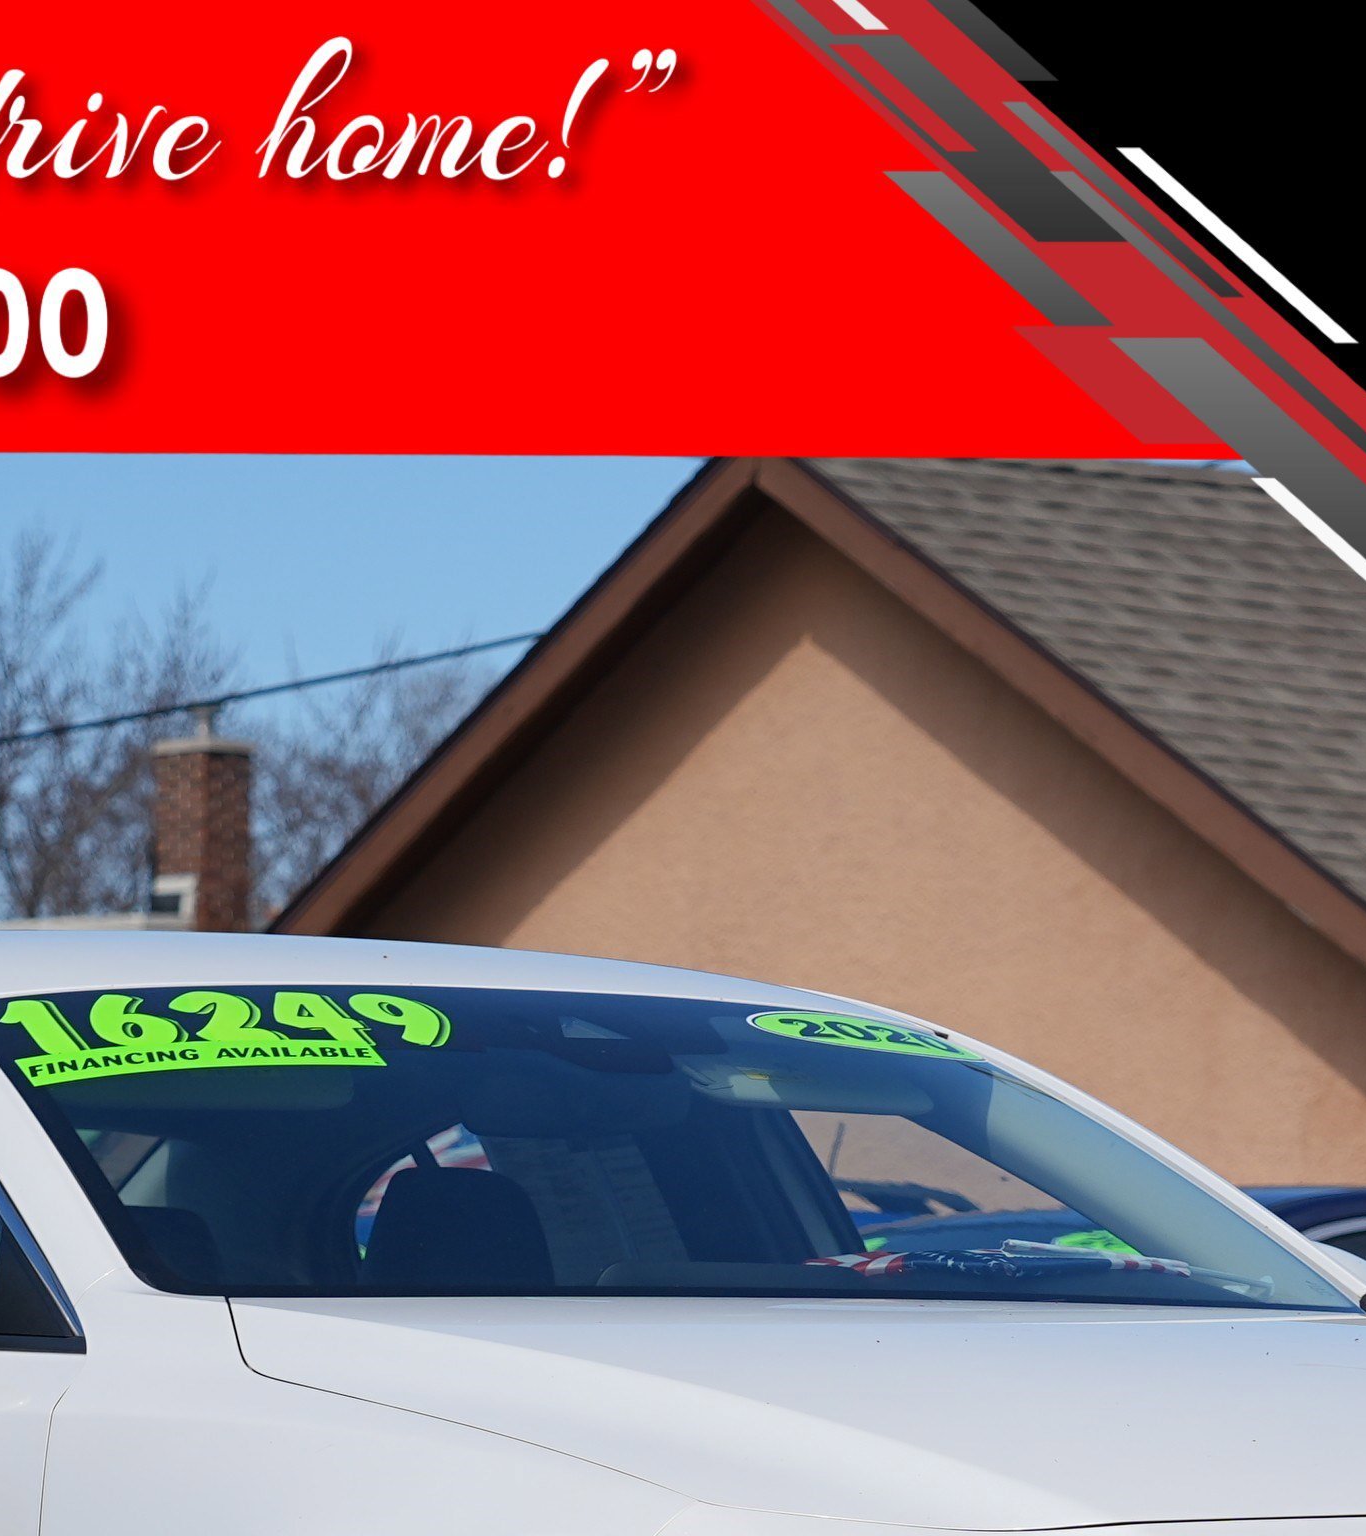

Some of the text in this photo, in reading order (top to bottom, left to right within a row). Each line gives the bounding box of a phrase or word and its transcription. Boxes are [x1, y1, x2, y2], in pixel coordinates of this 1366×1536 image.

[0, 991, 451, 1055] 16249
[779, 1018, 964, 1055] 2020
[30, 1045, 373, 1078] FINANCING AVAILABLE
